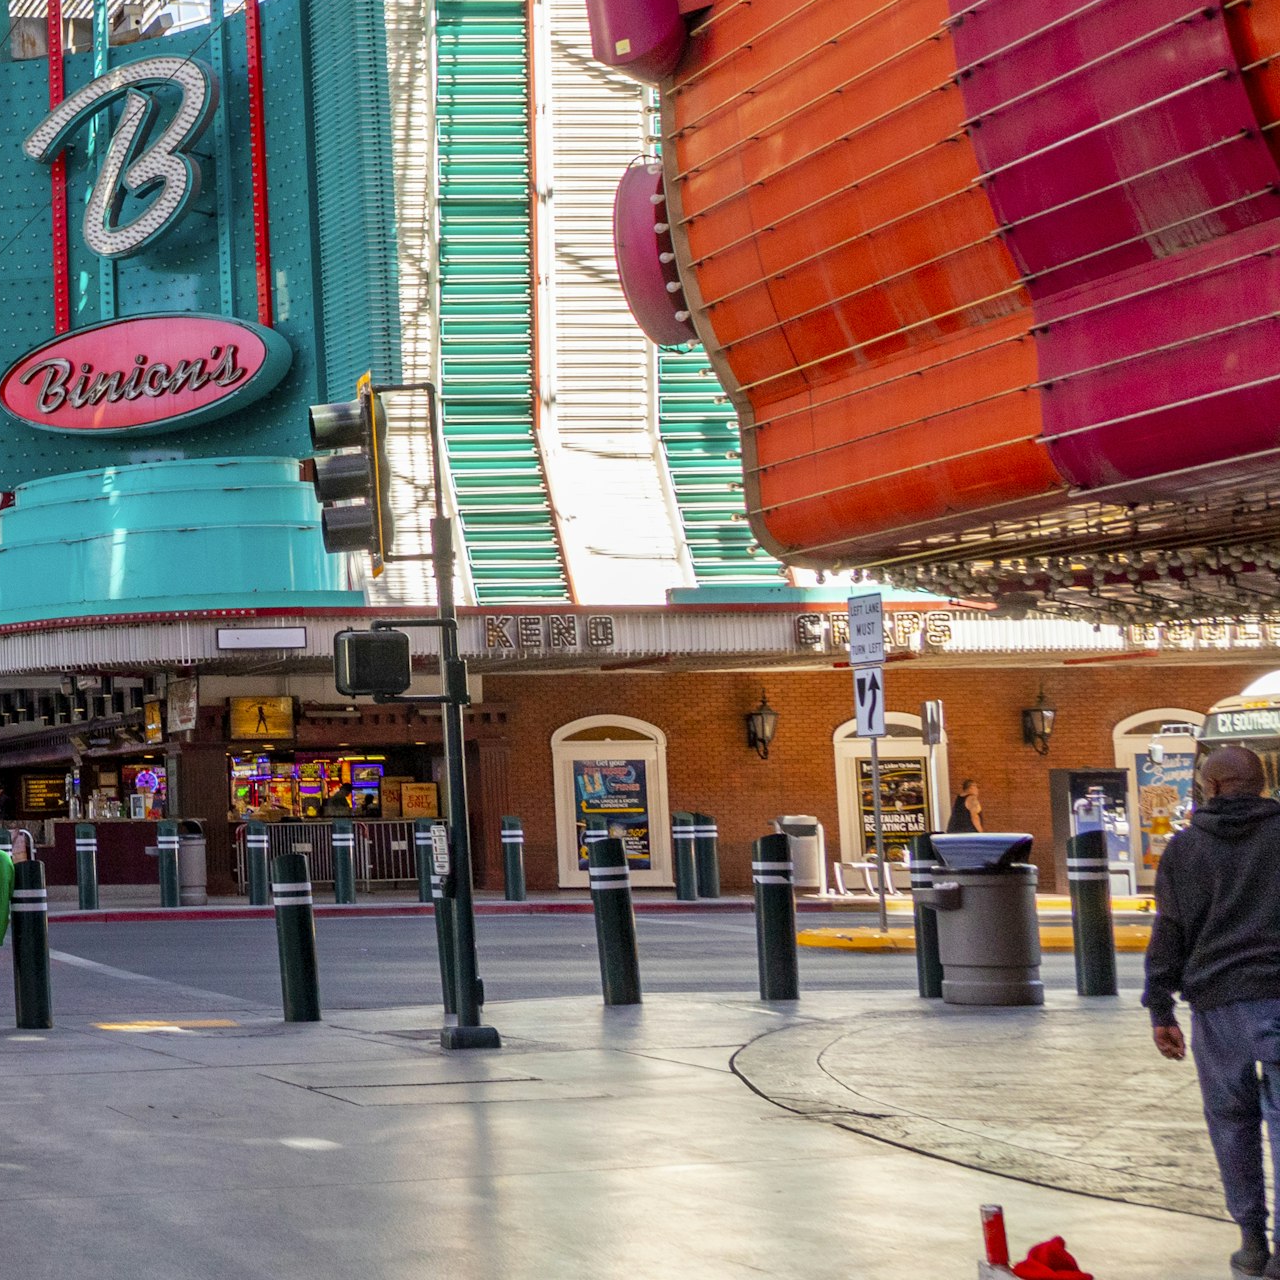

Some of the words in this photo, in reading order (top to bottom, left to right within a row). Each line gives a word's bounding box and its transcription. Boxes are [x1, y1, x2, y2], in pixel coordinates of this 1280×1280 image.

[22, 54, 219, 261] B
[17, 342, 250, 414] Binion's
[850, 606, 863, 616] LEFT
[864, 602, 880, 615] LANE
[485, 614, 614, 649] KENO
[856, 622, 876, 636] MUST
[851, 645, 866, 656] TURN
[868, 642, 882, 654] LEFT
[1217, 713, 1233, 733] CX
[863, 814, 916, 823] RETAURANT
[865, 823, 906, 832] ROATING
[907, 822, 925, 832] BAR
